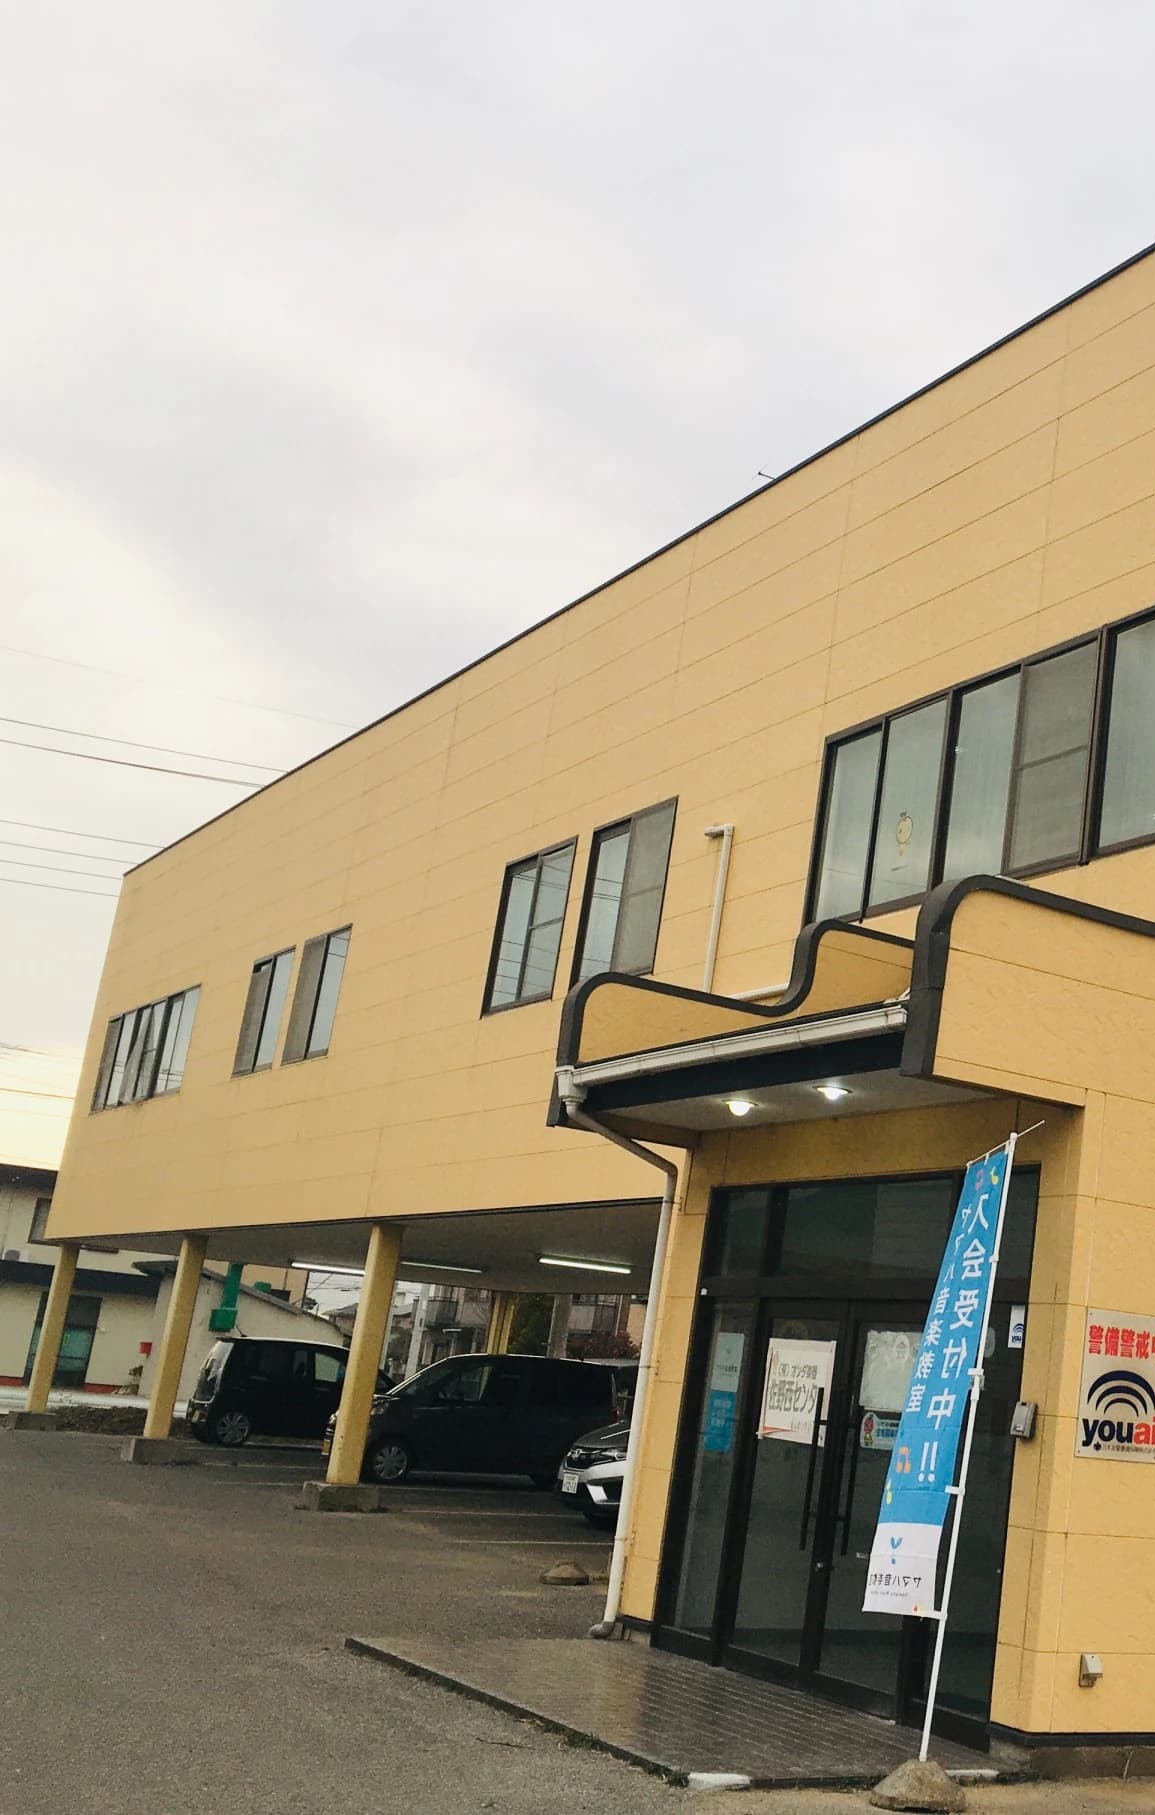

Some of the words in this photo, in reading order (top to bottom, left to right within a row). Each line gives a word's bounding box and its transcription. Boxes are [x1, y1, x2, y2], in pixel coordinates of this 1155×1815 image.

[768, 1379, 818, 1414] 佐野西センタ
